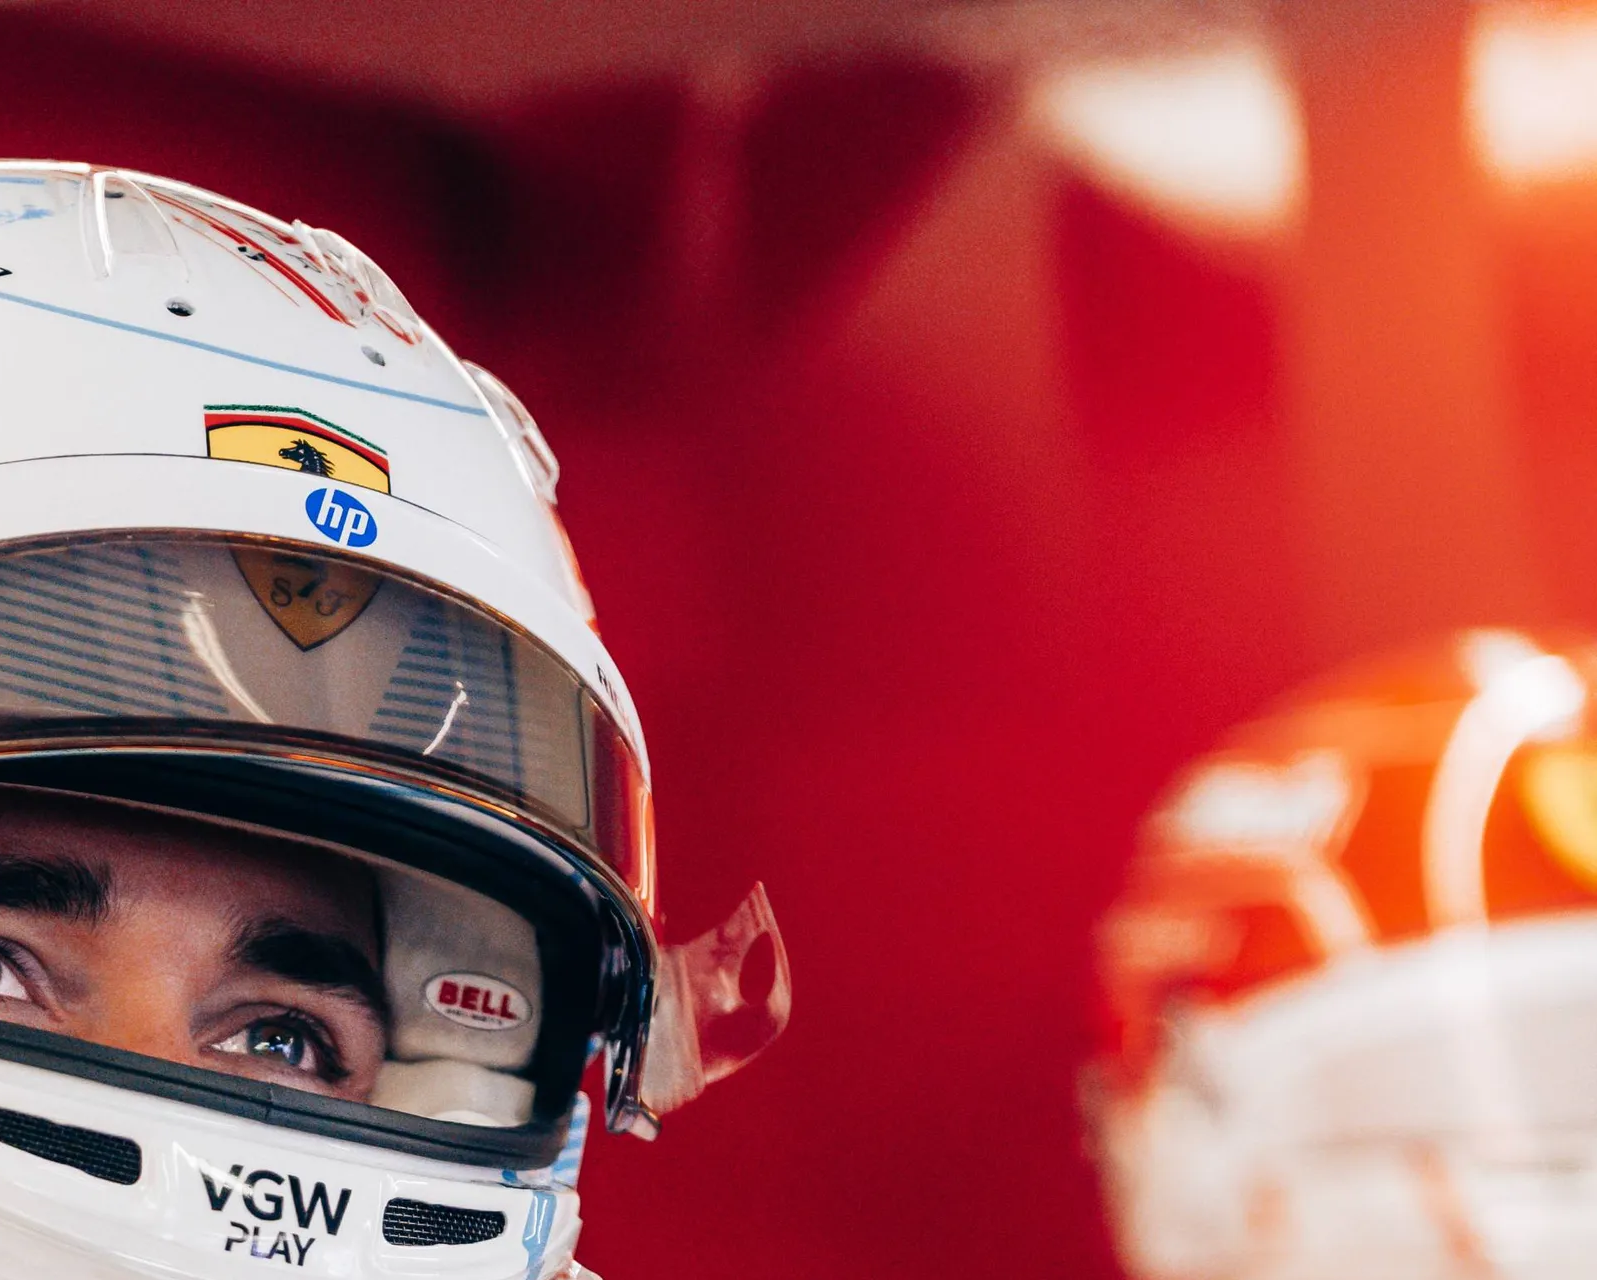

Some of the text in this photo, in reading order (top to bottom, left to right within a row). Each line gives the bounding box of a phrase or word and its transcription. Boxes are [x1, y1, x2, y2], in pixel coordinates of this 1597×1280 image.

[315, 487, 370, 547] hp
[438, 980, 517, 1020] BELL
[200, 1163, 352, 1236] VGW
[224, 1220, 316, 1267] PLAY
